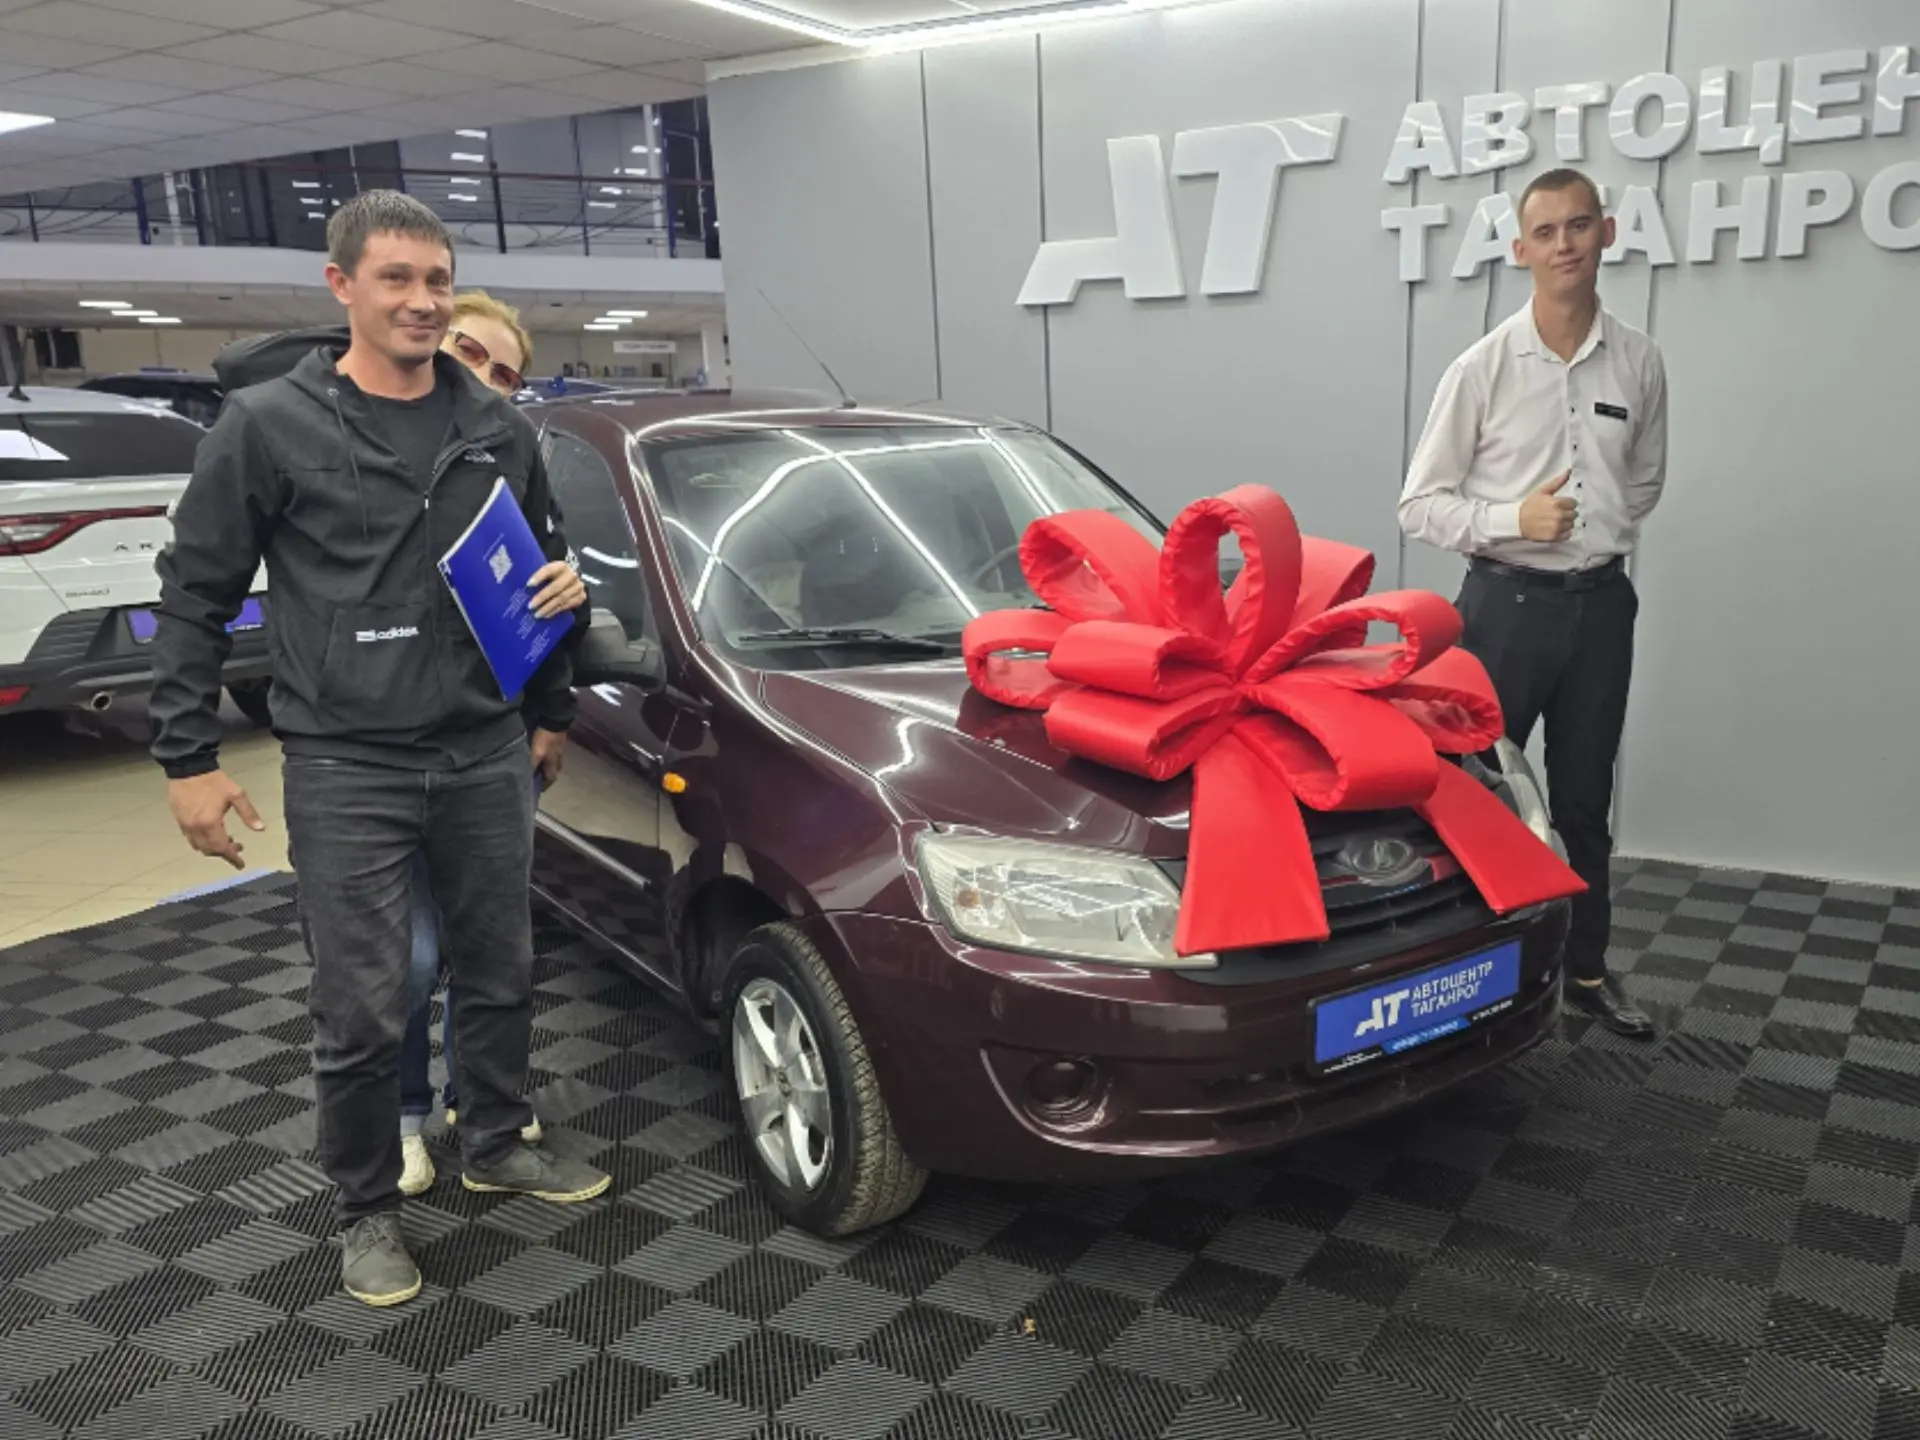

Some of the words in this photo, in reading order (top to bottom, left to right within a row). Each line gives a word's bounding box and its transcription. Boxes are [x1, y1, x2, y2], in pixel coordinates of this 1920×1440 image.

[1381, 160, 1920, 283] ТААНРО
[1411, 981, 1481, 1018] ТАГАНРОГ
[1412, 960, 1493, 1001] АВТОЦЕНТР
